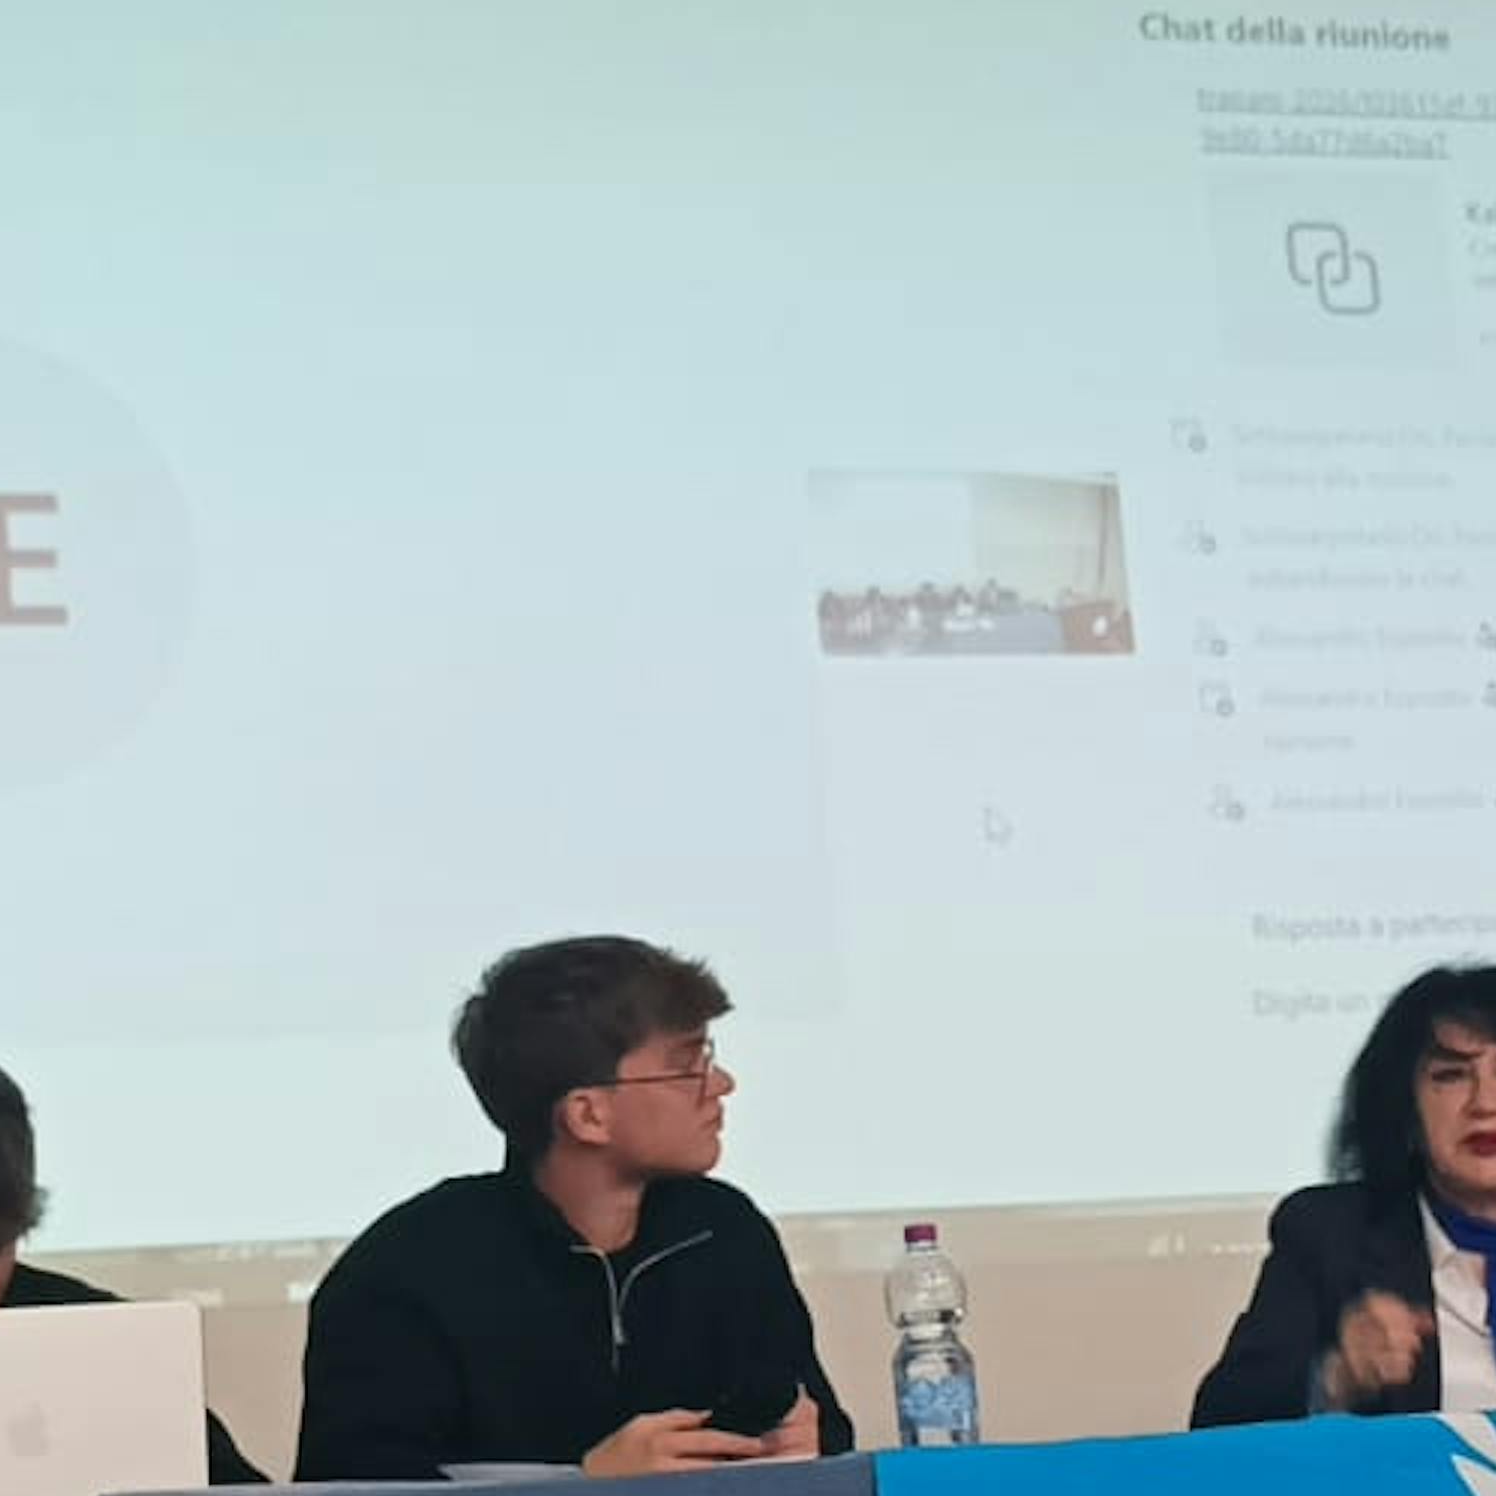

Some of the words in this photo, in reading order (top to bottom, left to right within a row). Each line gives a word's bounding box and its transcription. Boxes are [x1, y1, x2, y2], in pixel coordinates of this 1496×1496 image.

[1138, 12, 1214, 45] Chat
[1225, 16, 1306, 48] della
[1315, 19, 1451, 54] riunione
